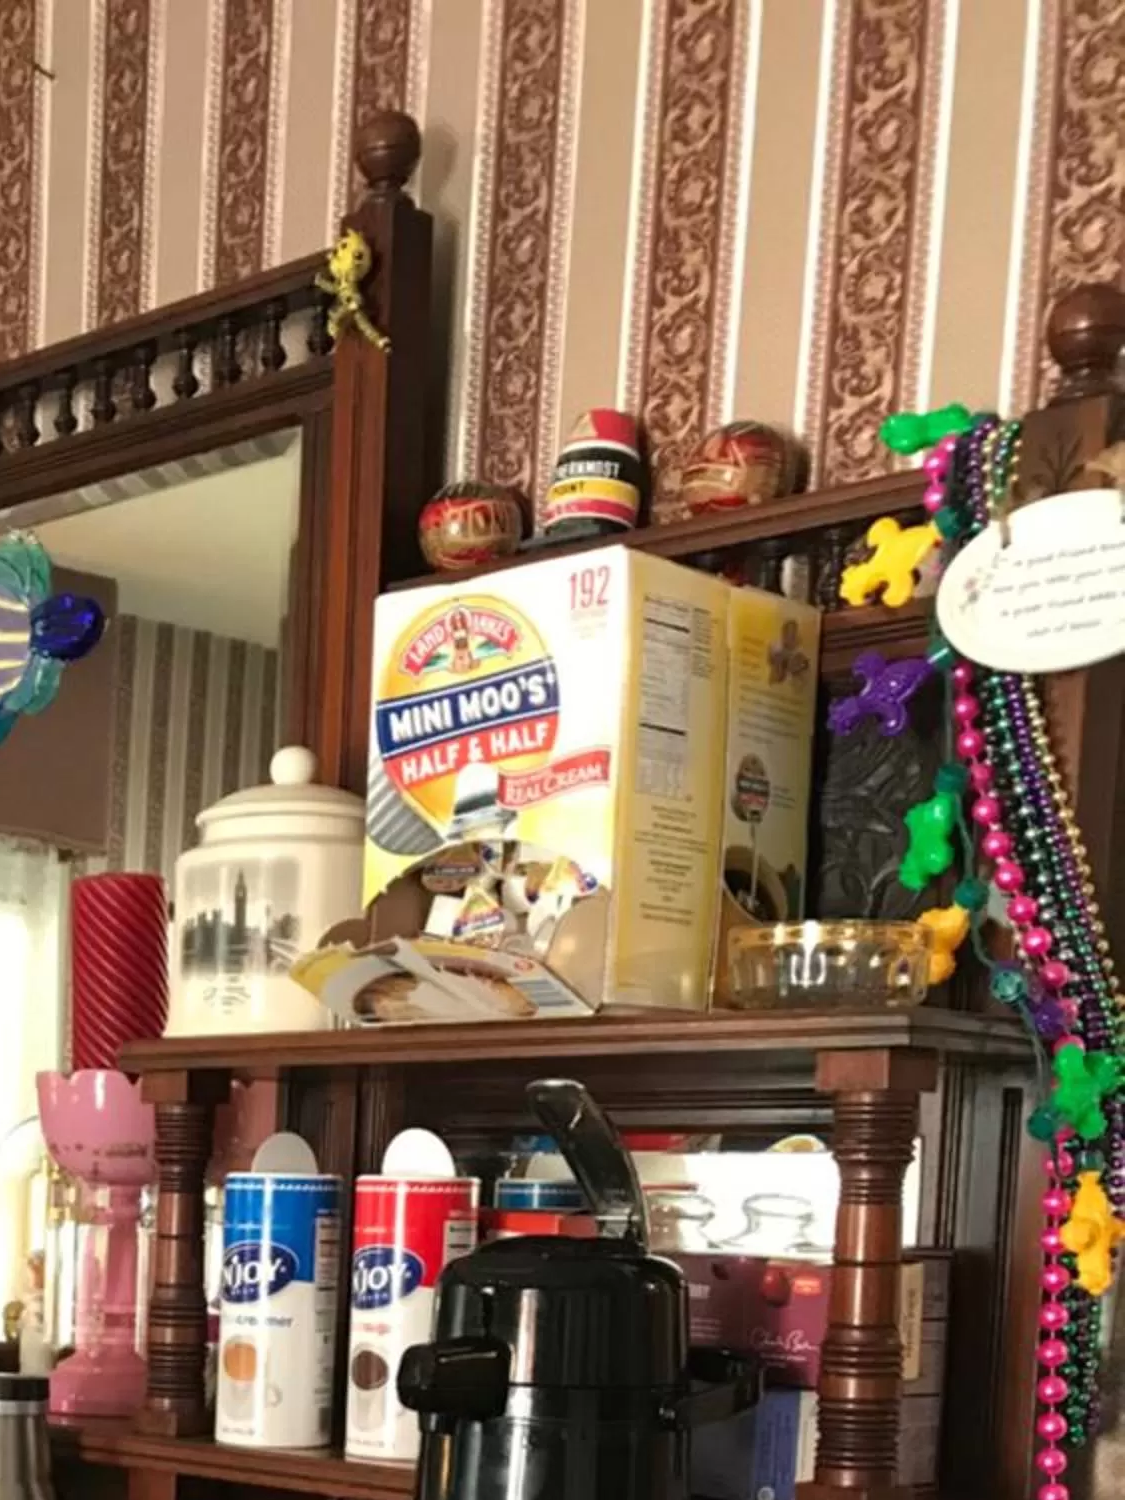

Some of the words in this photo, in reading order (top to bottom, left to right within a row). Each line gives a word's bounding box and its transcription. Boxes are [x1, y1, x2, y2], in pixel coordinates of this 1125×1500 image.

[568, 566, 611, 610] 192
[408, 625, 445, 666] LAND
[388, 697, 454, 743] MINI
[458, 675, 548, 725] MOO'S
[401, 743, 460, 785] HALF
[467, 736, 483, 762] &
[490, 722, 550, 755] HALF
[504, 779, 541, 803] REAL
[543, 763, 604, 793] CREAM
